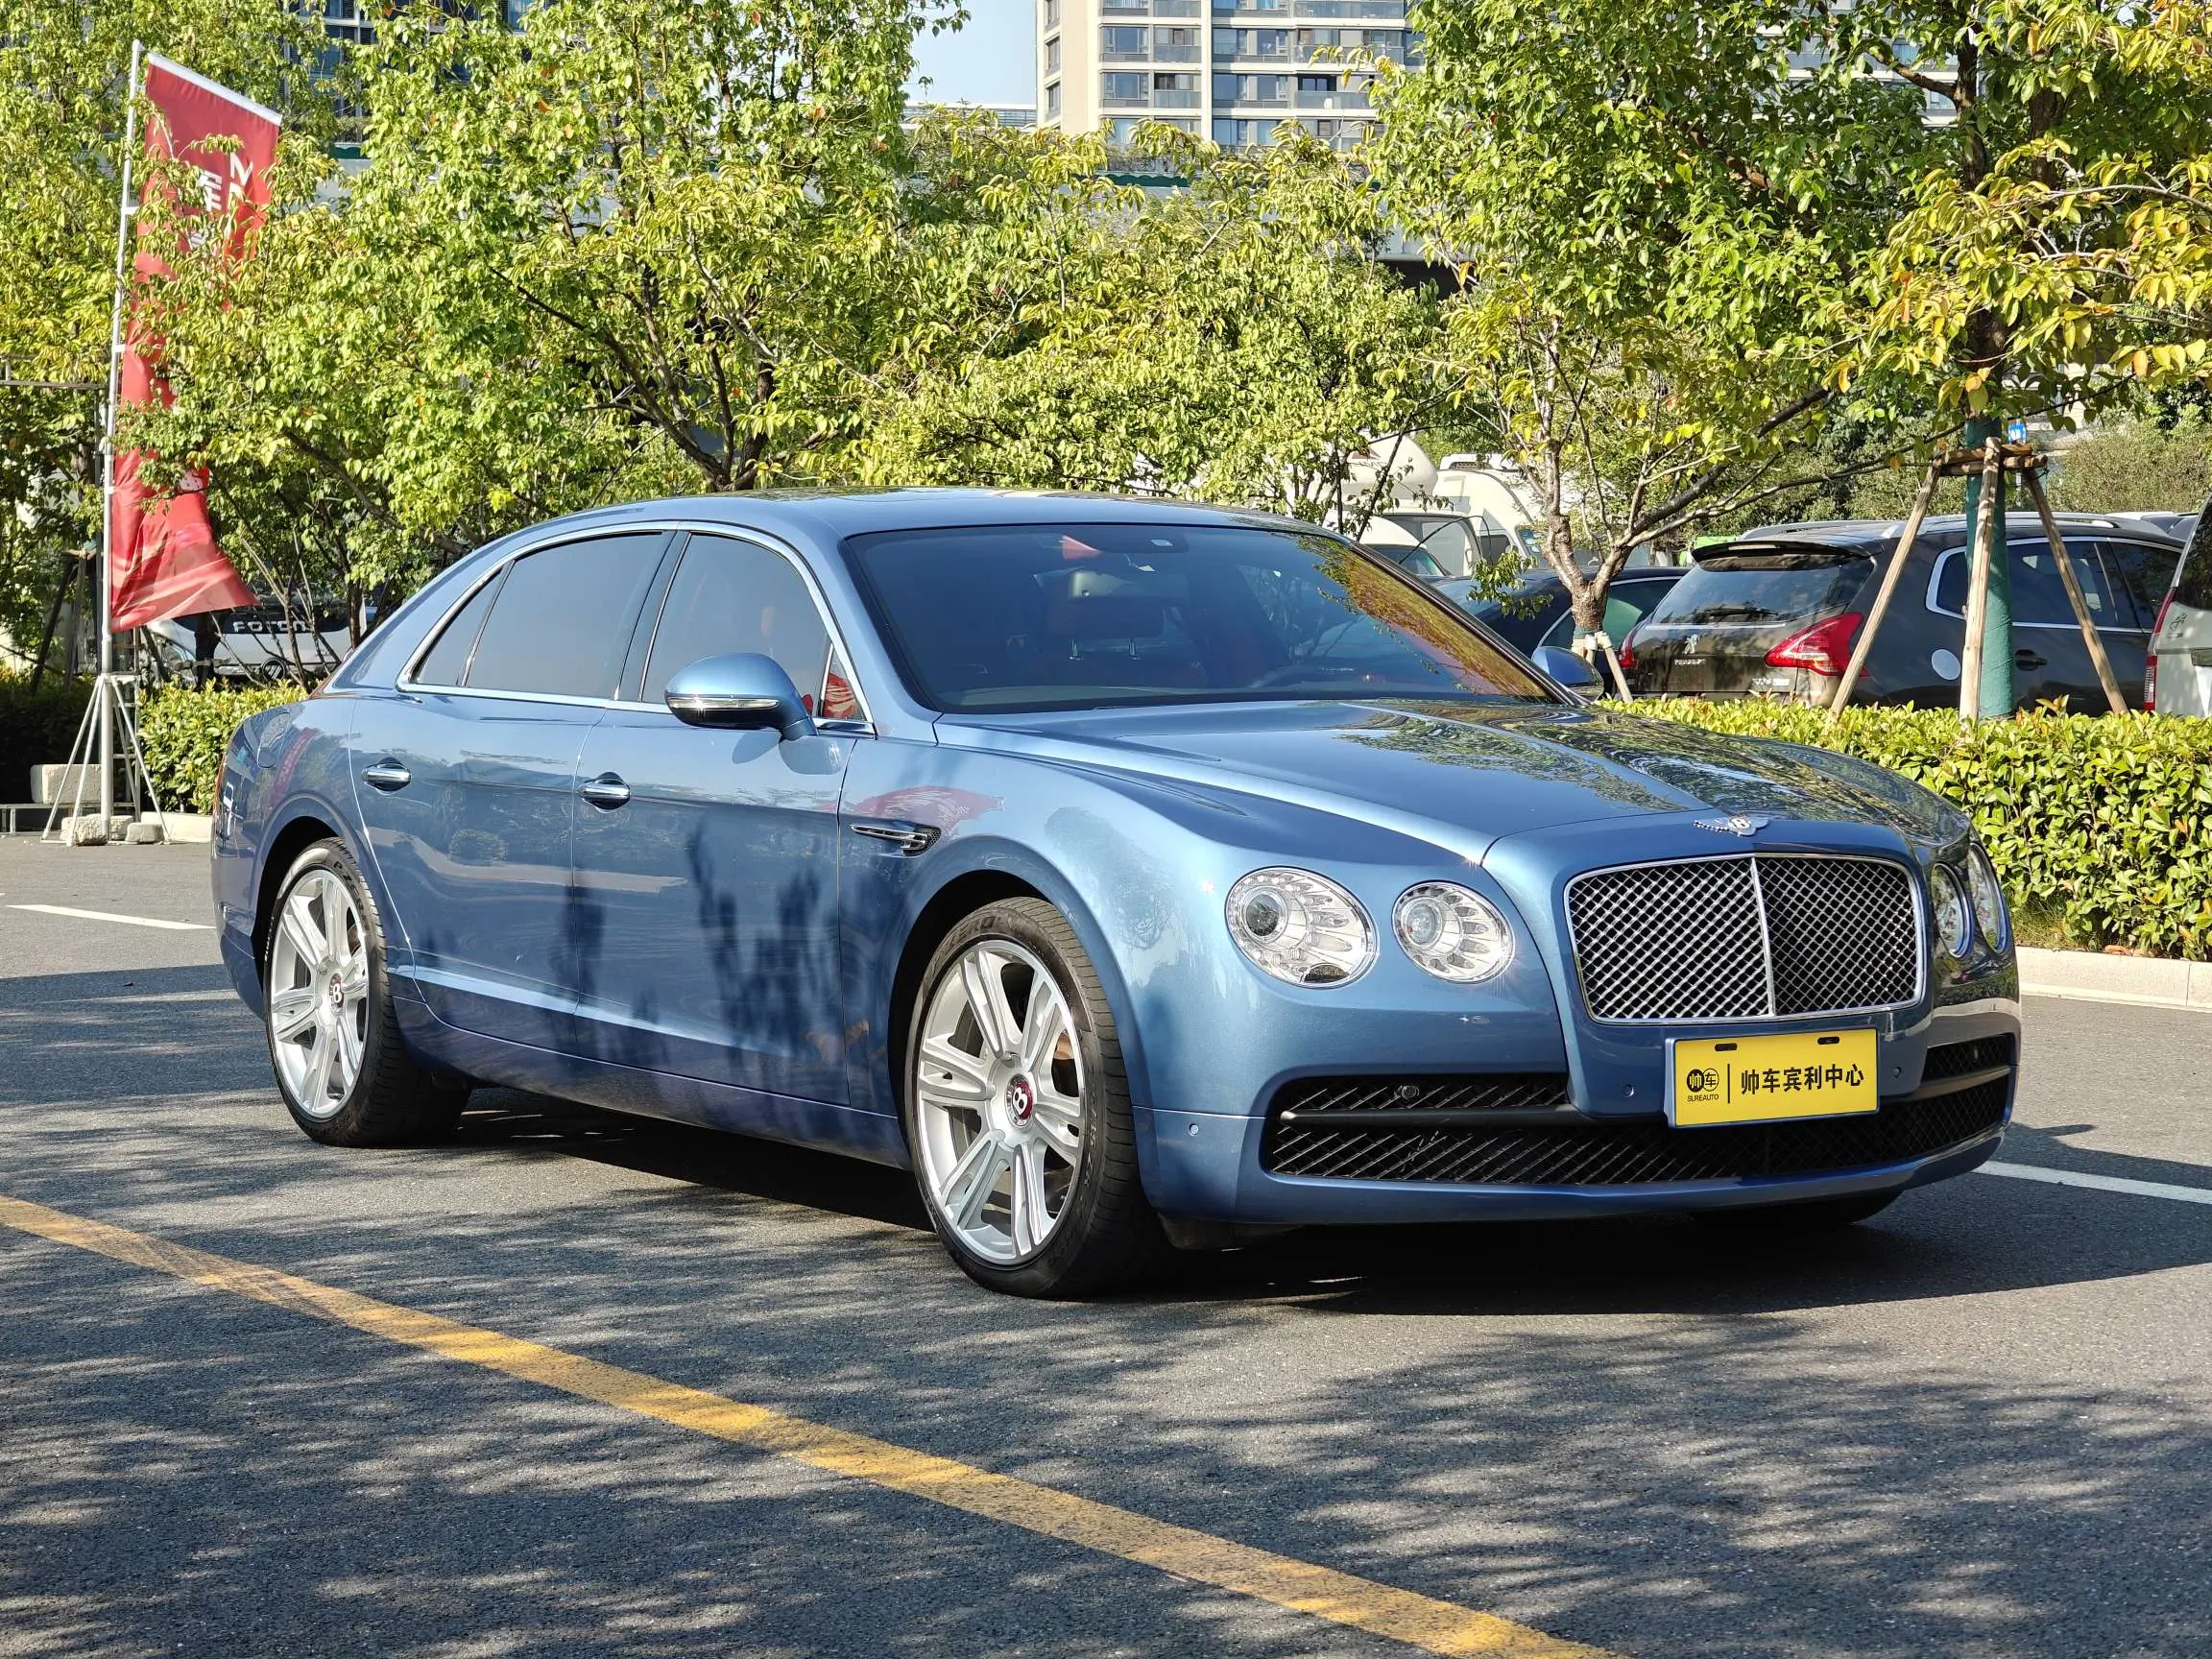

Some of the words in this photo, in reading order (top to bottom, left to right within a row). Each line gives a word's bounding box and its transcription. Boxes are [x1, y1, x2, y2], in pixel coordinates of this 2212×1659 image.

[1741, 1063, 1863, 1094] 帅车宾利中心
[1687, 1094, 1719, 1102] SUREAUTO
